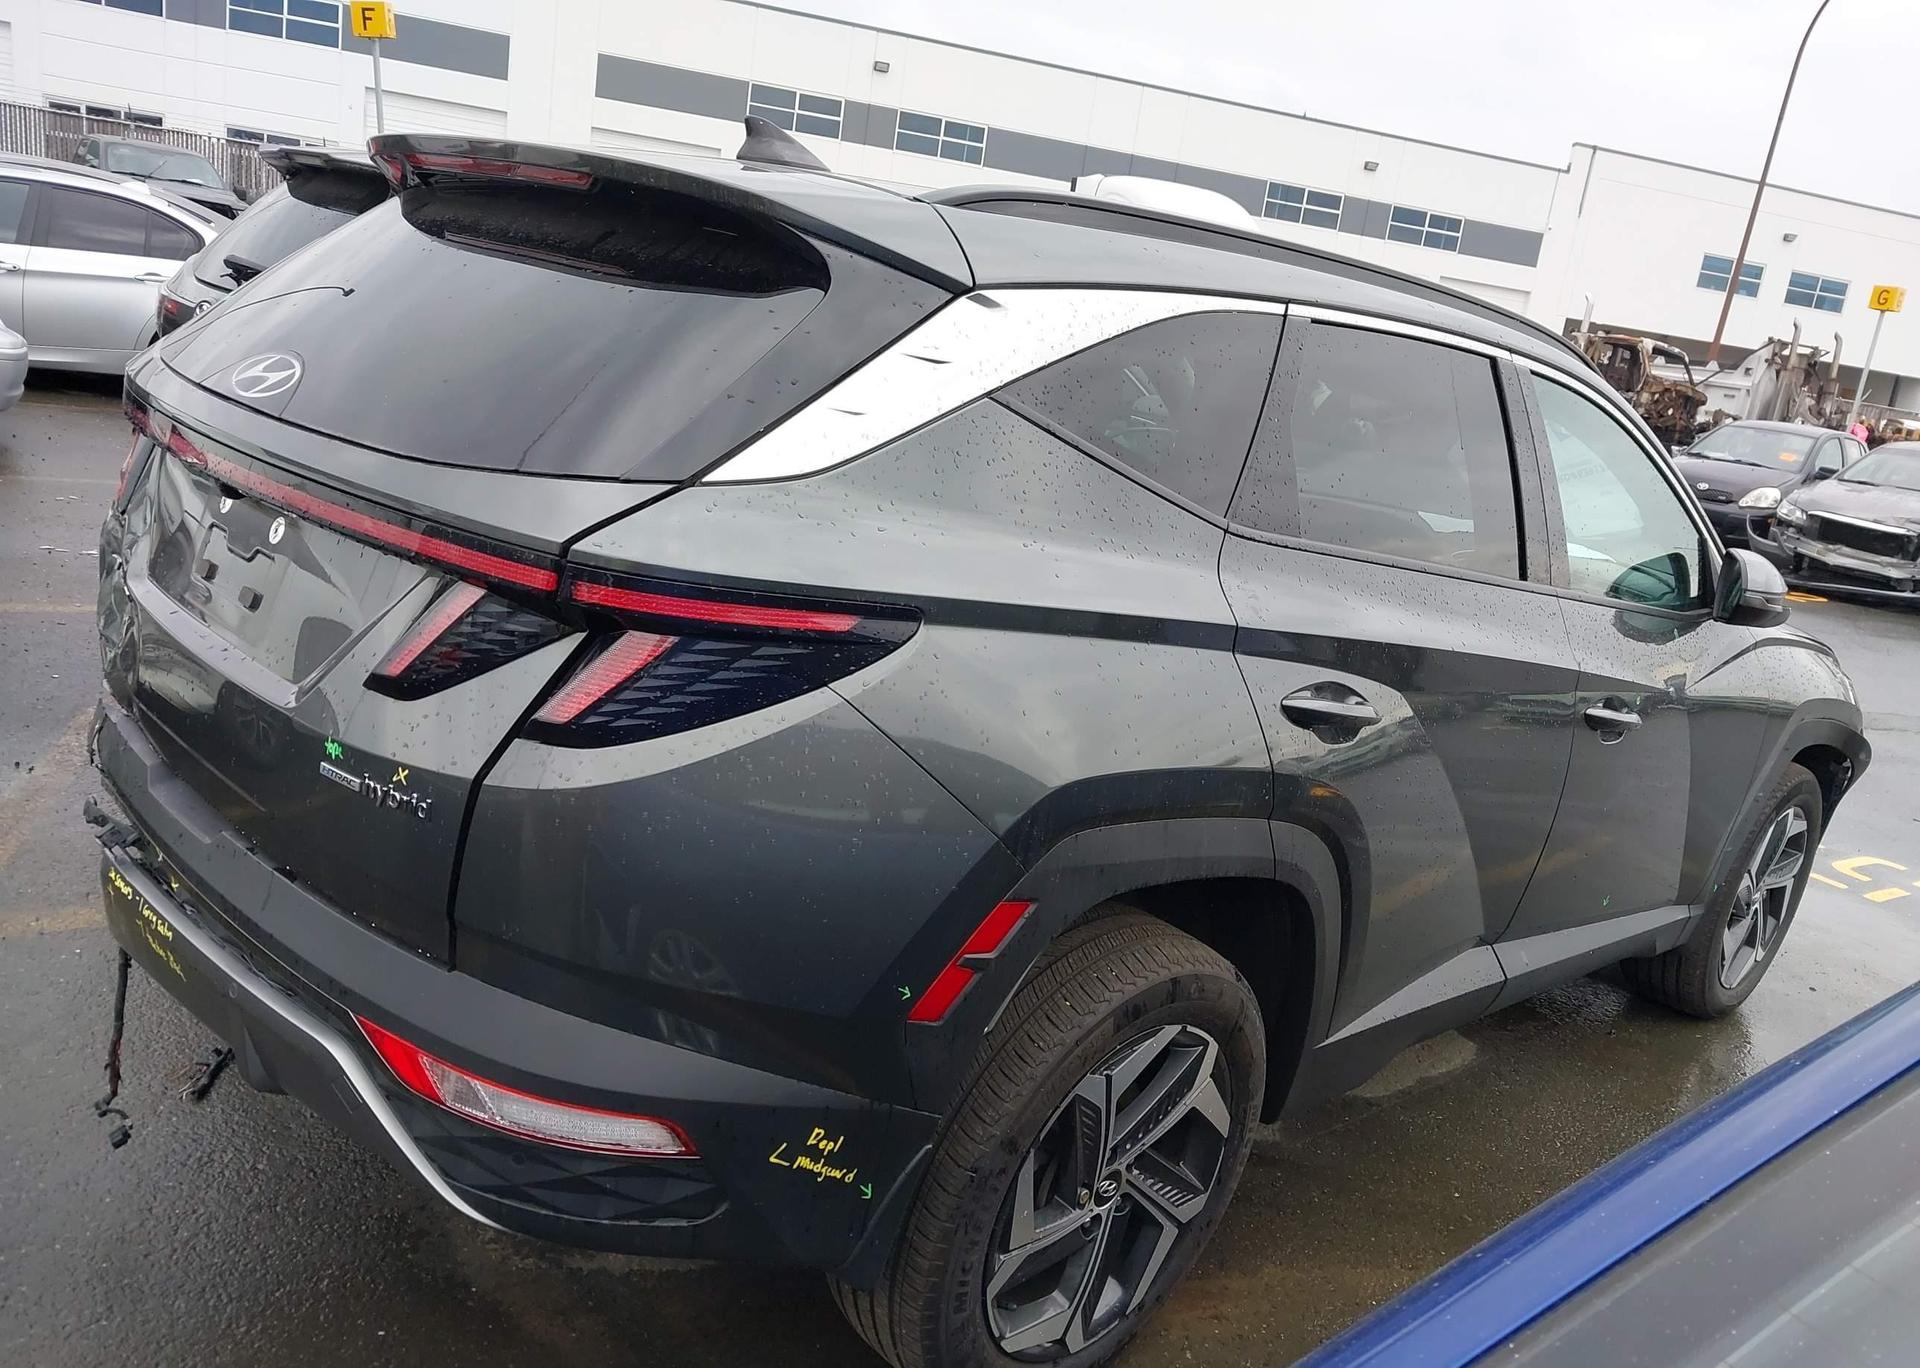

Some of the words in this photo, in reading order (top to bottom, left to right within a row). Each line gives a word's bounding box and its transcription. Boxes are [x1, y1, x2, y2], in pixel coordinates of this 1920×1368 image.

[361, 7, 376, 31] F
[1877, 289, 1890, 306] G
[361, 772, 433, 820] hybrid
